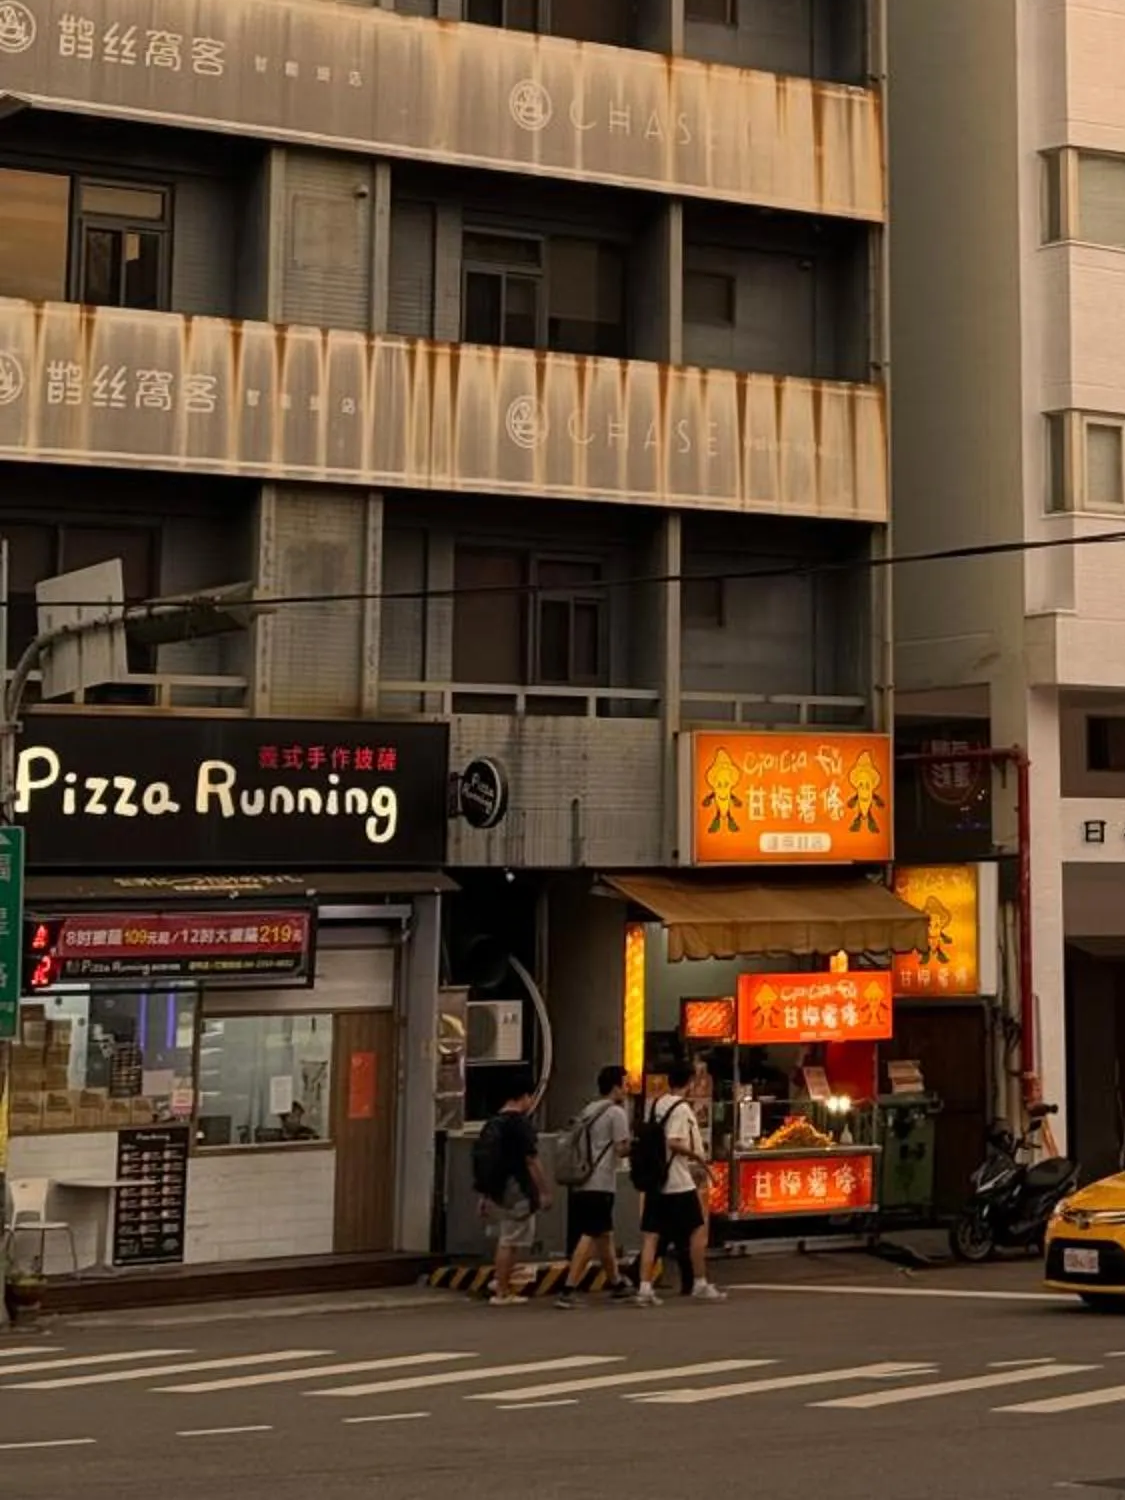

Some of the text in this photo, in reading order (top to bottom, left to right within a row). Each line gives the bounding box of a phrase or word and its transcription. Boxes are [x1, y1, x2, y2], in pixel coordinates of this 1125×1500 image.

[567, 408, 720, 457] CHASE
[15, 746, 398, 844] Pizza Running
[745, 782, 845, 824] 甘梅薯條
